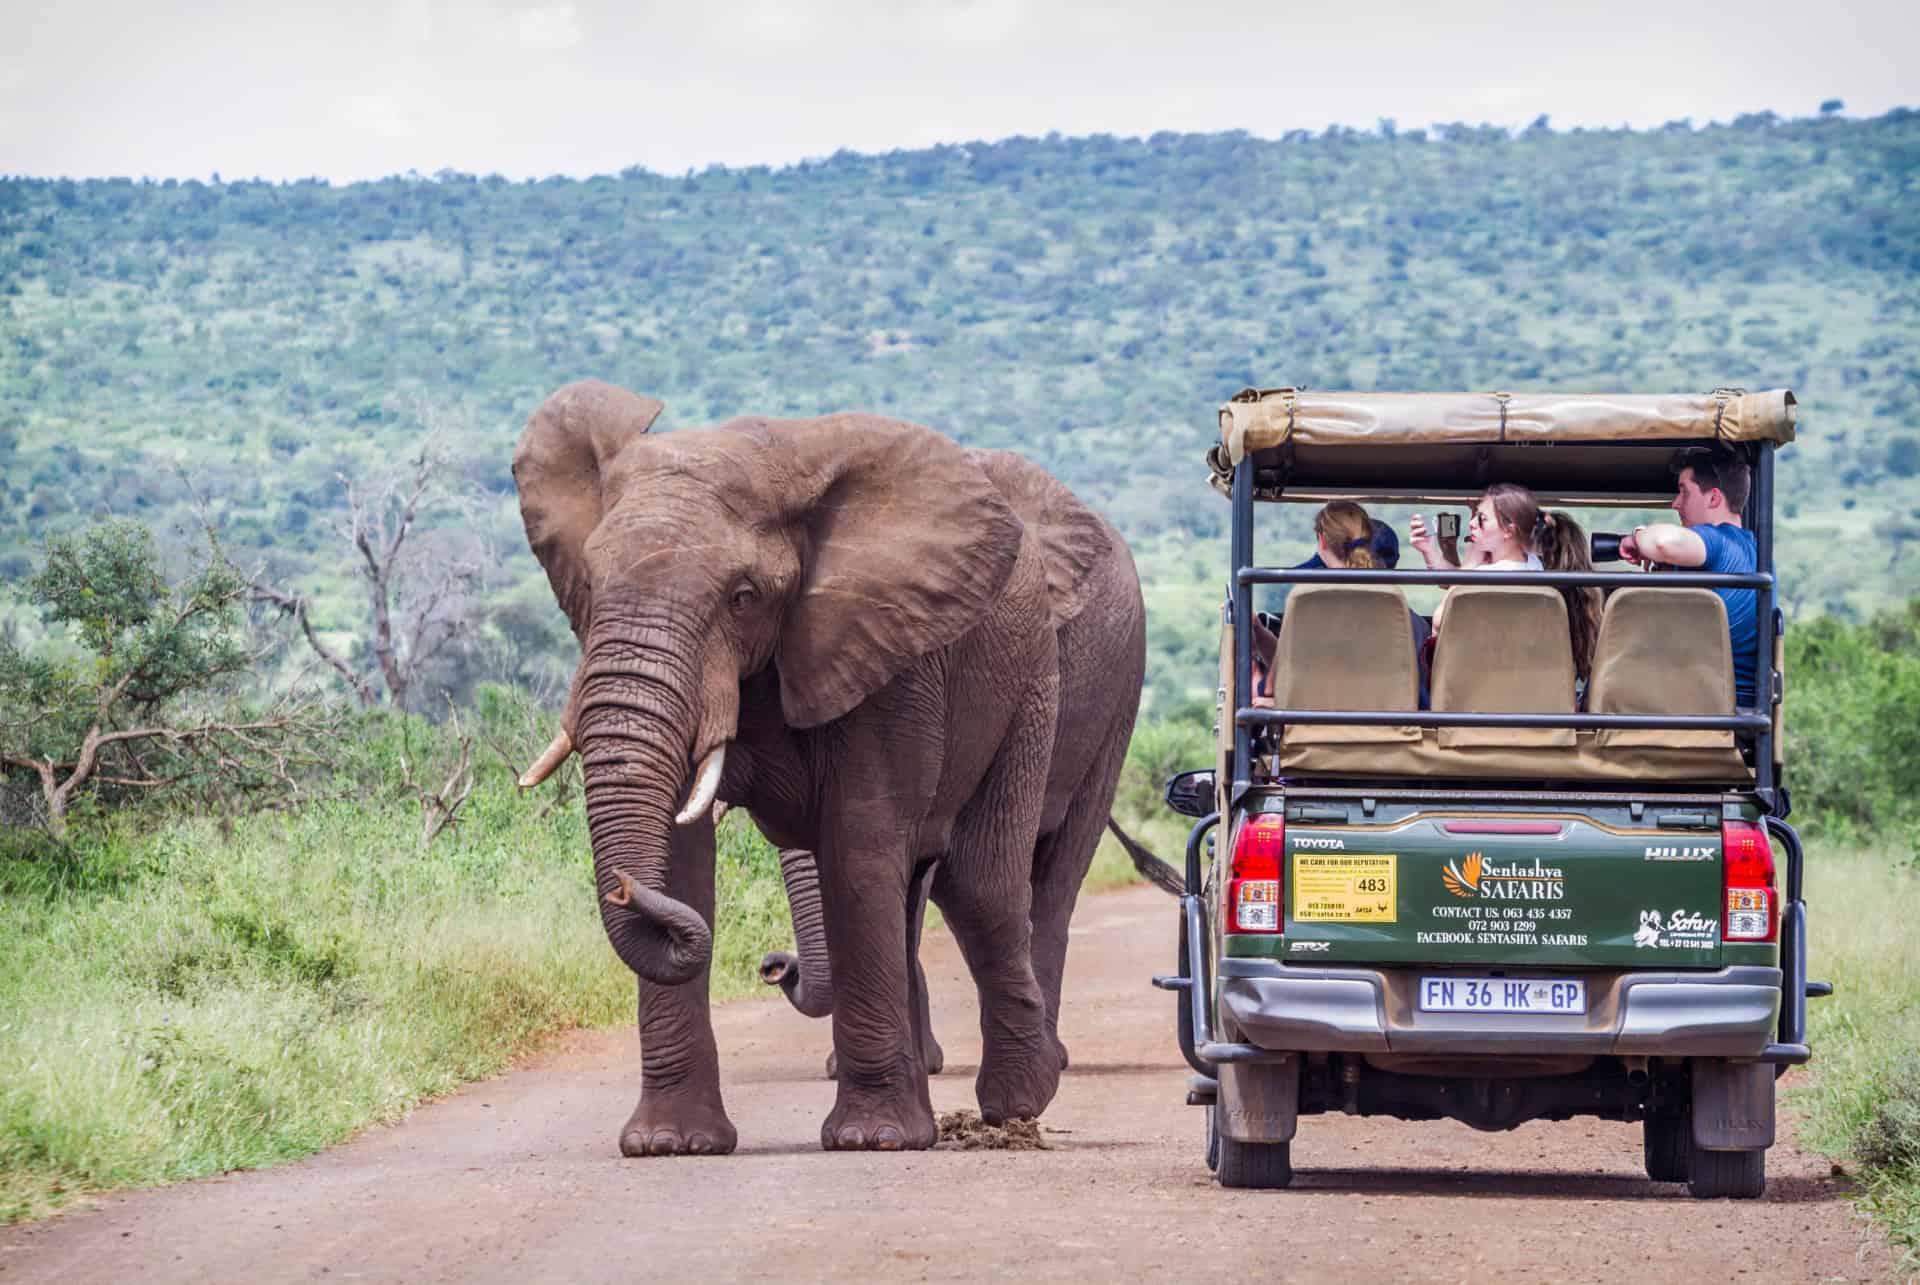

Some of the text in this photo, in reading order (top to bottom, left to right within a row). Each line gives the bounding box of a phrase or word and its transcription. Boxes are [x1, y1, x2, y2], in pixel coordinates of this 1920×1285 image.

[1293, 838, 1345, 849] TOYOTA
[1644, 847, 1715, 861] HILUX
[1481, 856, 1563, 881] Sentashya
[1358, 879, 1386, 892] 483
[1480, 880, 1564, 899] SAFARIS
[1432, 906, 1481, 918] CONTACT
[1503, 907, 1523, 919] 063
[1526, 908, 1545, 920] 435
[1667, 908, 1718, 932] Safari
[1468, 920, 1536, 932] 072 903 1299
[1477, 932, 1538, 945] SENTASHYA
[1541, 934, 1588, 946] SAFARIS
[1289, 942, 1331, 952] SRX
[1427, 981, 1578, 1009] FN 36 HK GP
